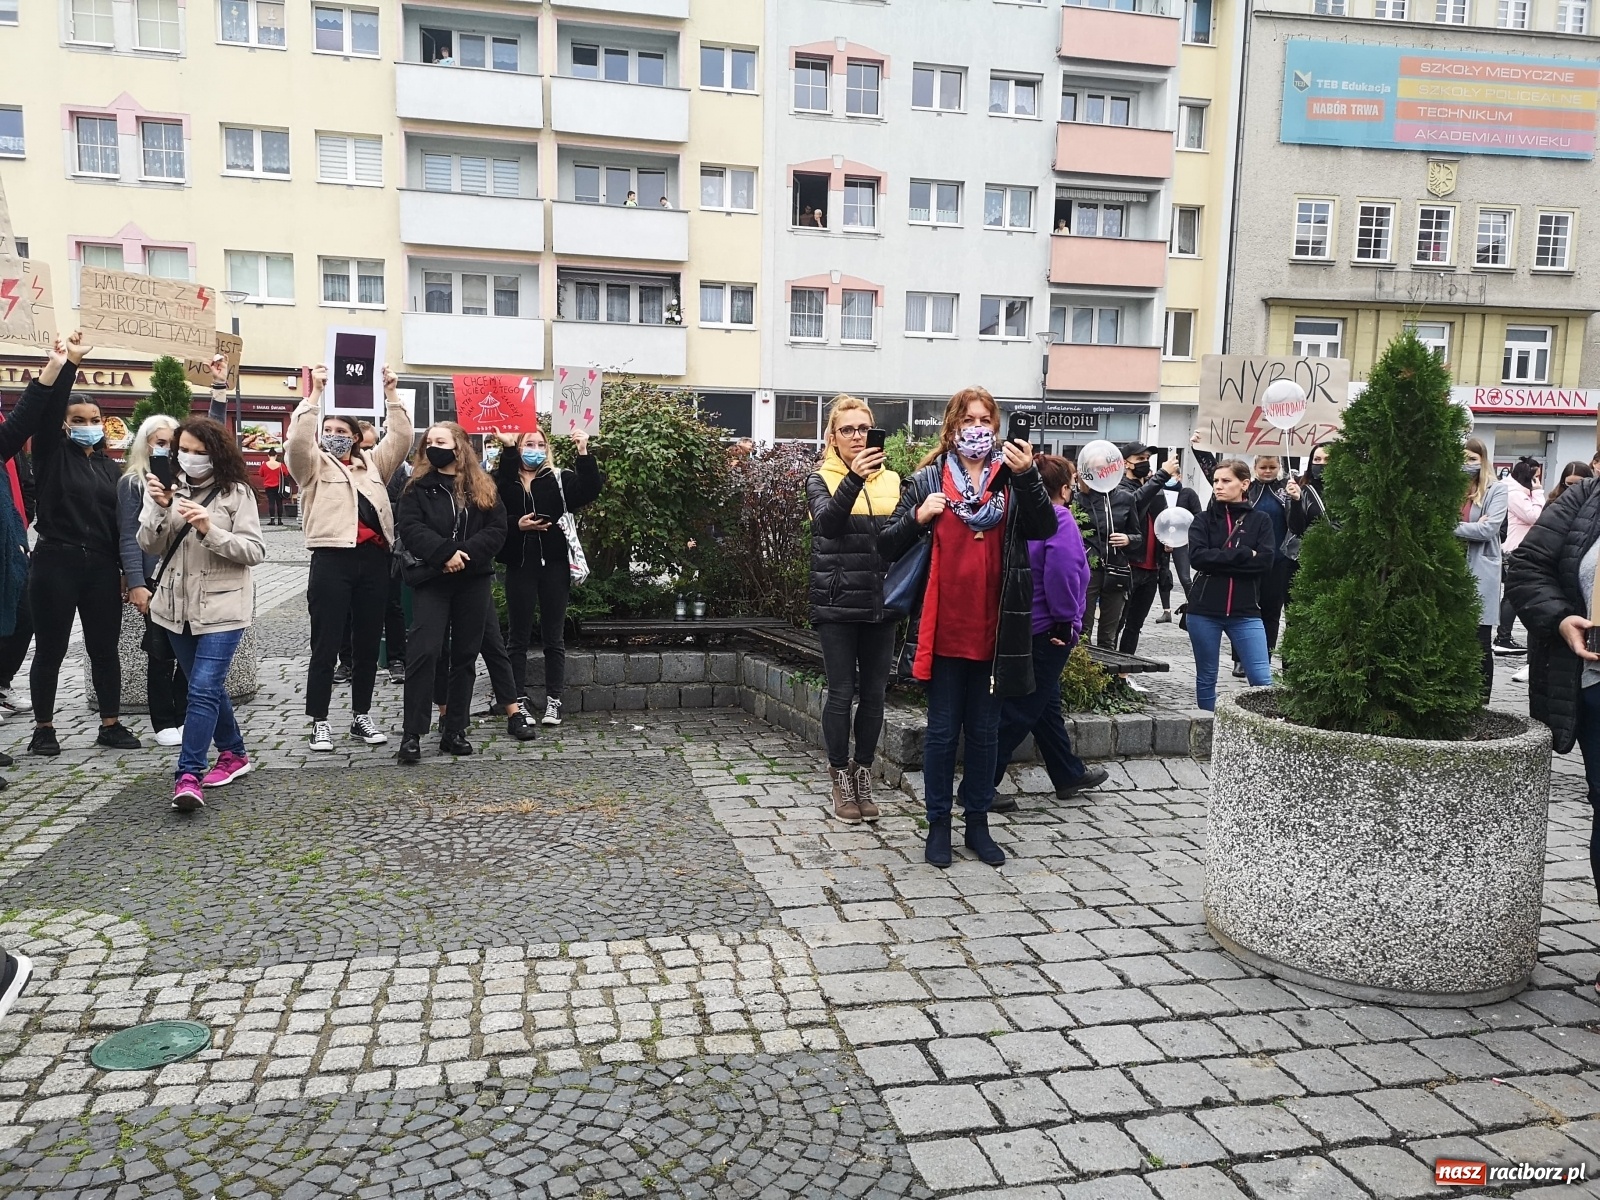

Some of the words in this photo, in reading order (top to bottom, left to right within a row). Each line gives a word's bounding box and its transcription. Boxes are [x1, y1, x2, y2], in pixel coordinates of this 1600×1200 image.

[1420, 62, 1482, 76] SZKOŁY
[1486, 66, 1575, 83] MEDYCZNE
[1316, 79, 1338, 89] TEB
[1341, 81, 1391, 94] Edukacja
[1418, 84, 1481, 98] SZKOŁY
[1485, 88, 1583, 105] POLICEALNE
[1312, 100, 1347, 115] NABÓR
[1350, 104, 1379, 116] TRWA
[1417, 106, 1513, 122] TECHNIKUM
[1414, 128, 1501, 144] AKADEMIA
[1505, 134, 1514, 144] III
[1518, 135, 1571, 147] WIEKU
[94, 272, 161, 297] WALCZCIE
[175, 286, 188, 300] Z
[99, 293, 172, 319] WIRUSEM,
[176, 303, 202, 320] NIE
[95, 315, 106, 330] Z
[117, 317, 208, 347] KOBIETAMI
[463, 376, 503, 387] CHCEMY
[499, 386, 520, 394] TEGO
[1218, 357, 1339, 405] WYBÓR
[1474, 388, 1588, 408] ROSSMANN
[1209, 417, 1245, 446] NIE
